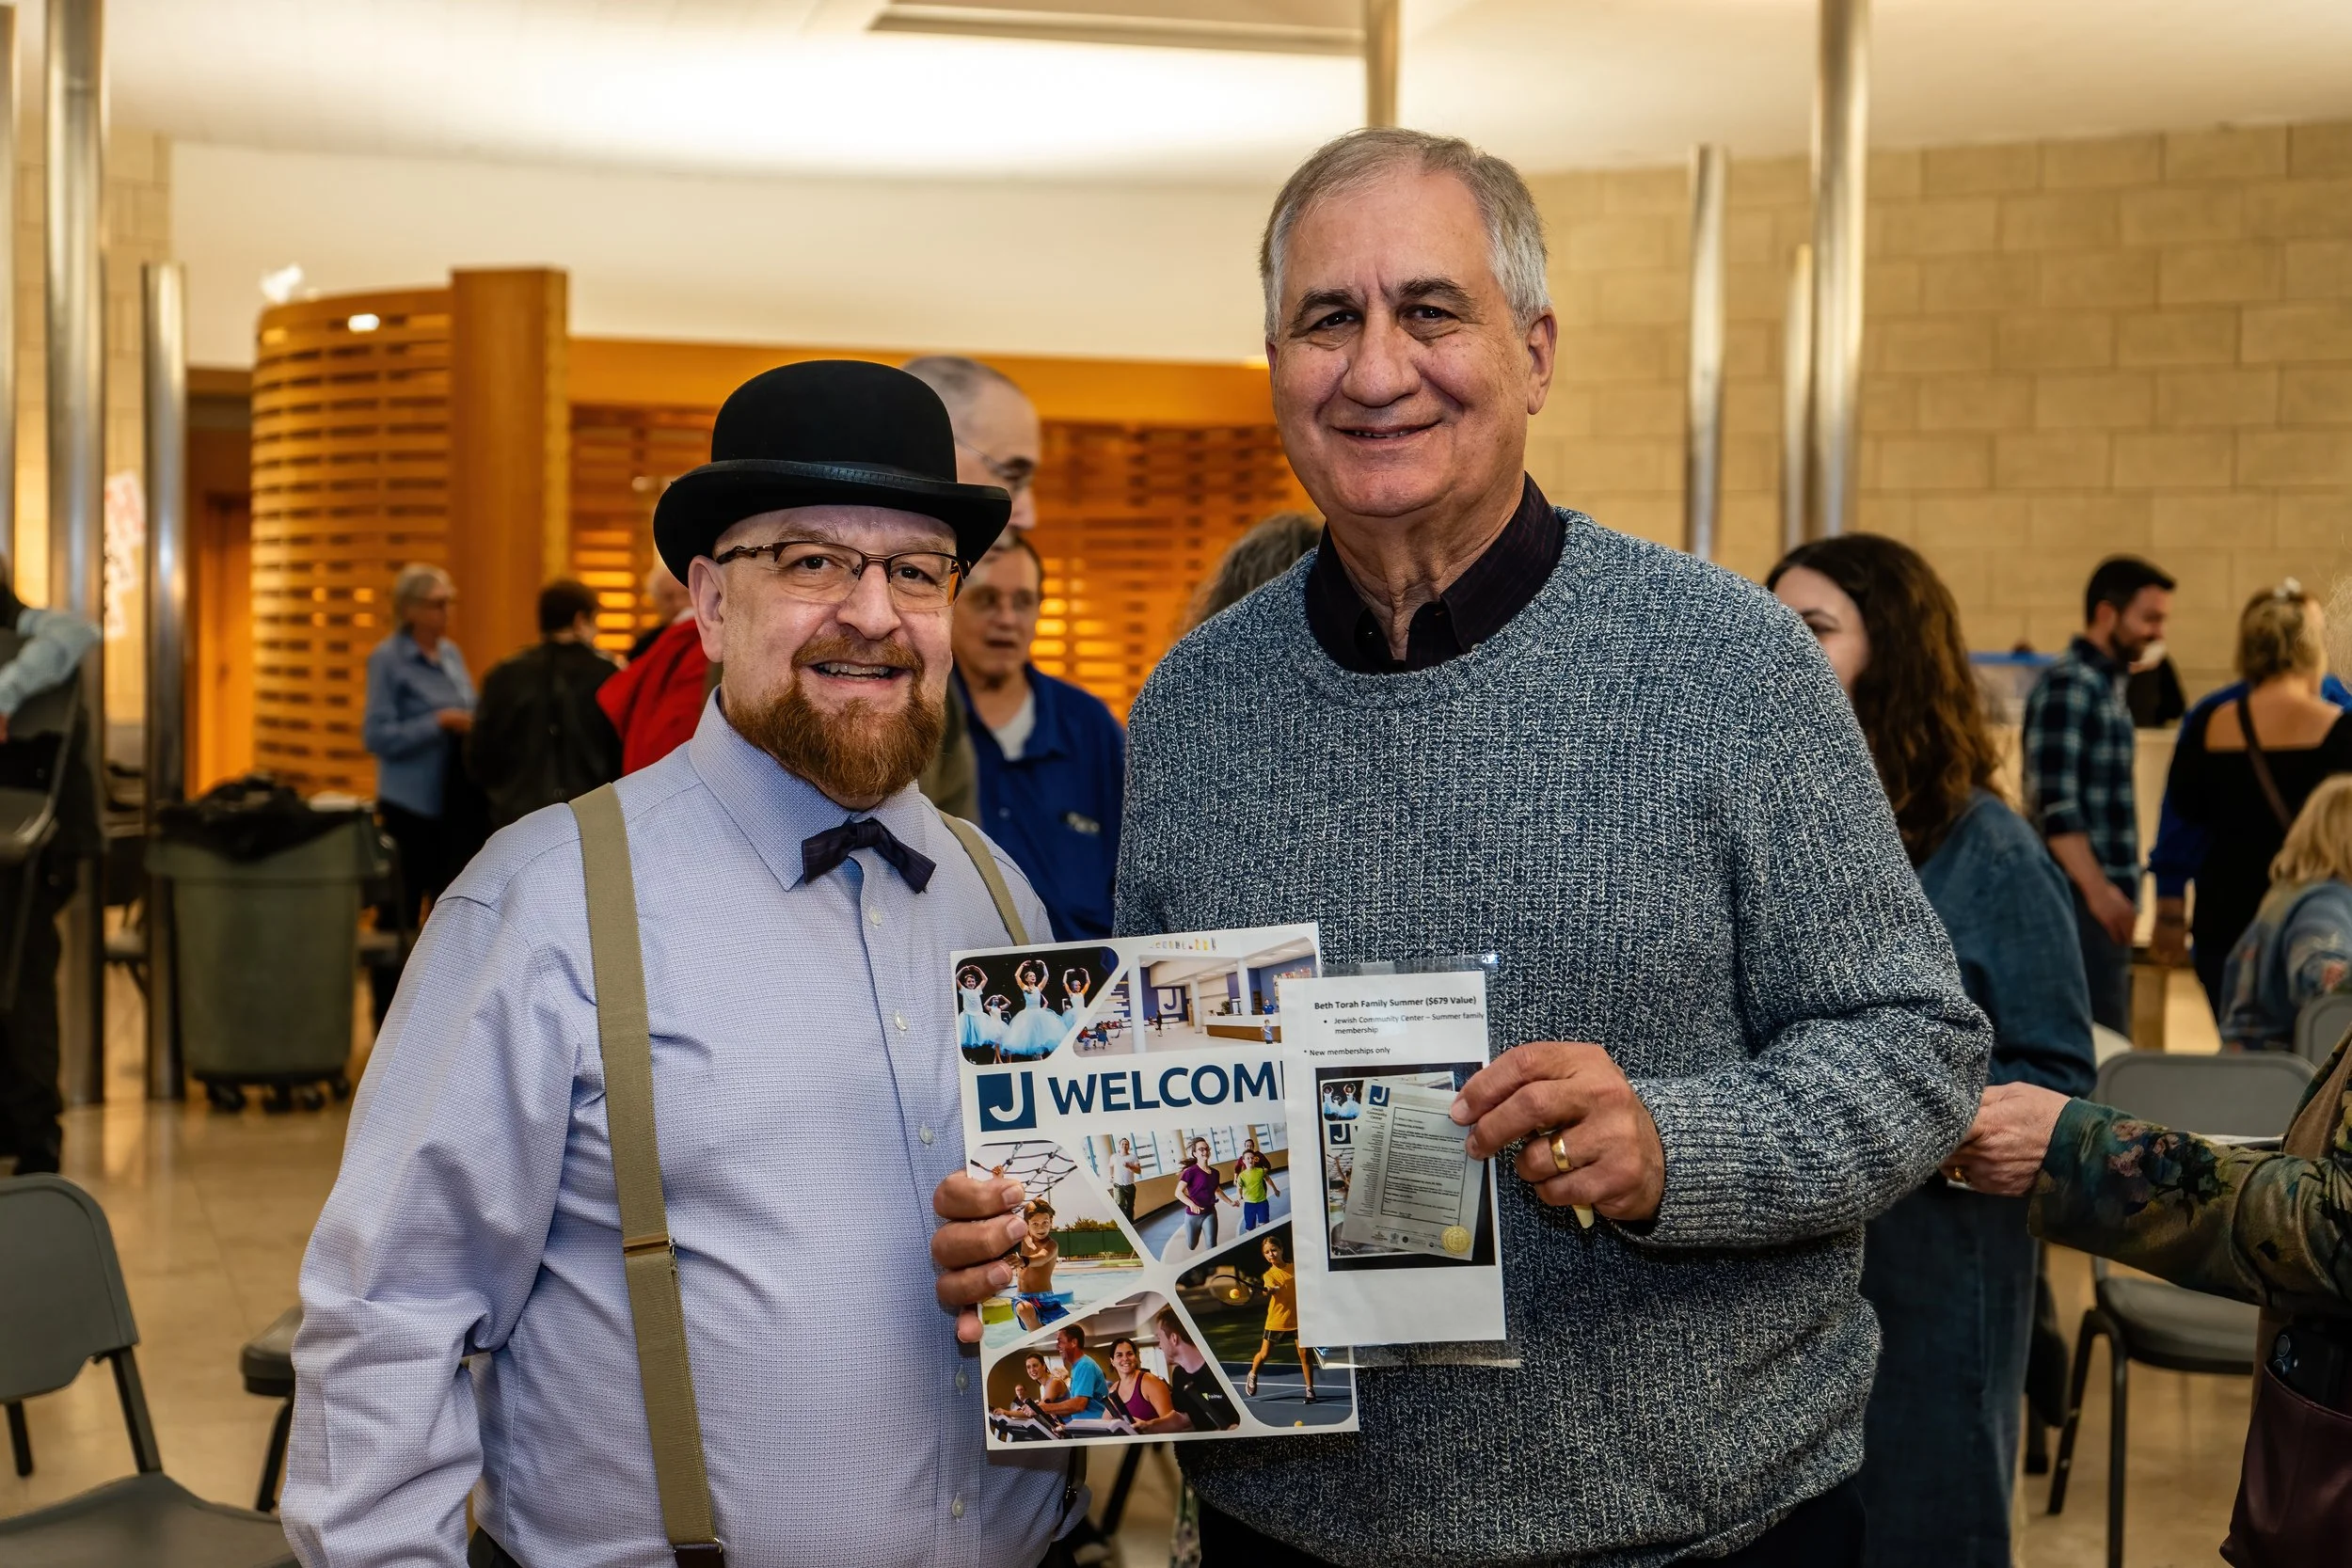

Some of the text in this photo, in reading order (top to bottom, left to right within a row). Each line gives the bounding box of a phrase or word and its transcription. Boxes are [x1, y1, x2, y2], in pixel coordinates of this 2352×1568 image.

[1314, 996, 1477, 1010] Beth Torah Family Summer ($679 Value)
[1359, 1015, 1400, 1024] Community
[1400, 1014, 1424, 1022] Center
[1463, 1011, 1485, 1021] family
[1334, 1026, 1379, 1036] membership
[1327, 1047, 1374, 1056] memberships
[1375, 1046, 1391, 1055] only
[1047, 1060, 1285, 1116] WELCOM
